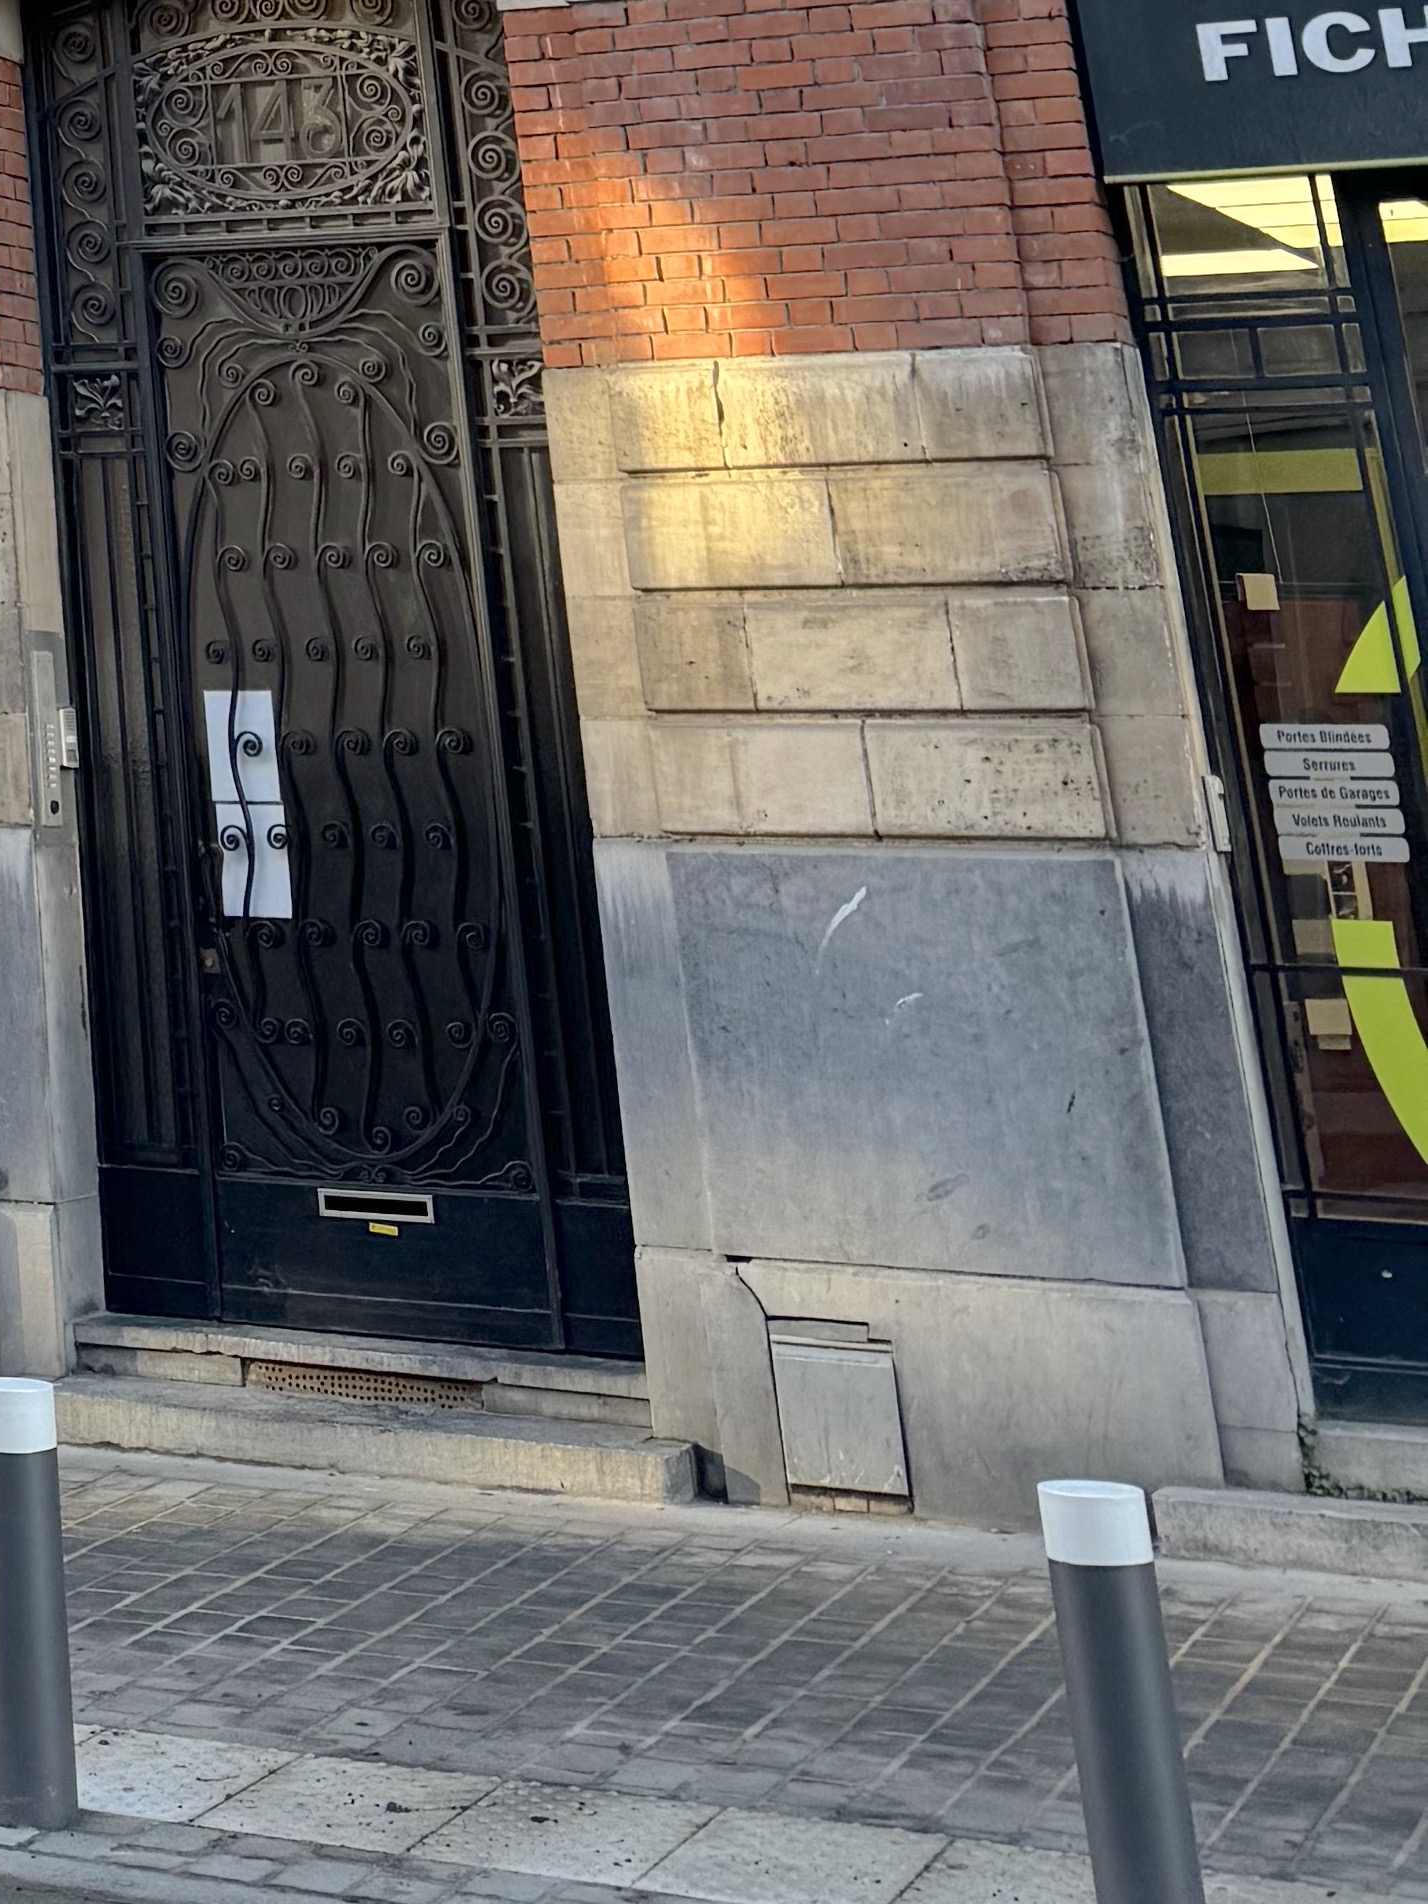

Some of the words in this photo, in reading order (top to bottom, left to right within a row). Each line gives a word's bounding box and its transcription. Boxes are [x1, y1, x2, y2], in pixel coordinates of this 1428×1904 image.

[216, 78, 342, 166] 143
[1277, 729, 1316, 743] Portes
[1319, 729, 1372, 744] Blindées
[1303, 757, 1356, 772] Serrures
[1278, 785, 1318, 799] Portes
[1321, 786, 1336, 800] de
[1339, 786, 1391, 802] Garages
[1292, 813, 1329, 828] Volets
[1332, 814, 1387, 828] Roulants
[1306, 841, 1383, 857] Coffres-forts
